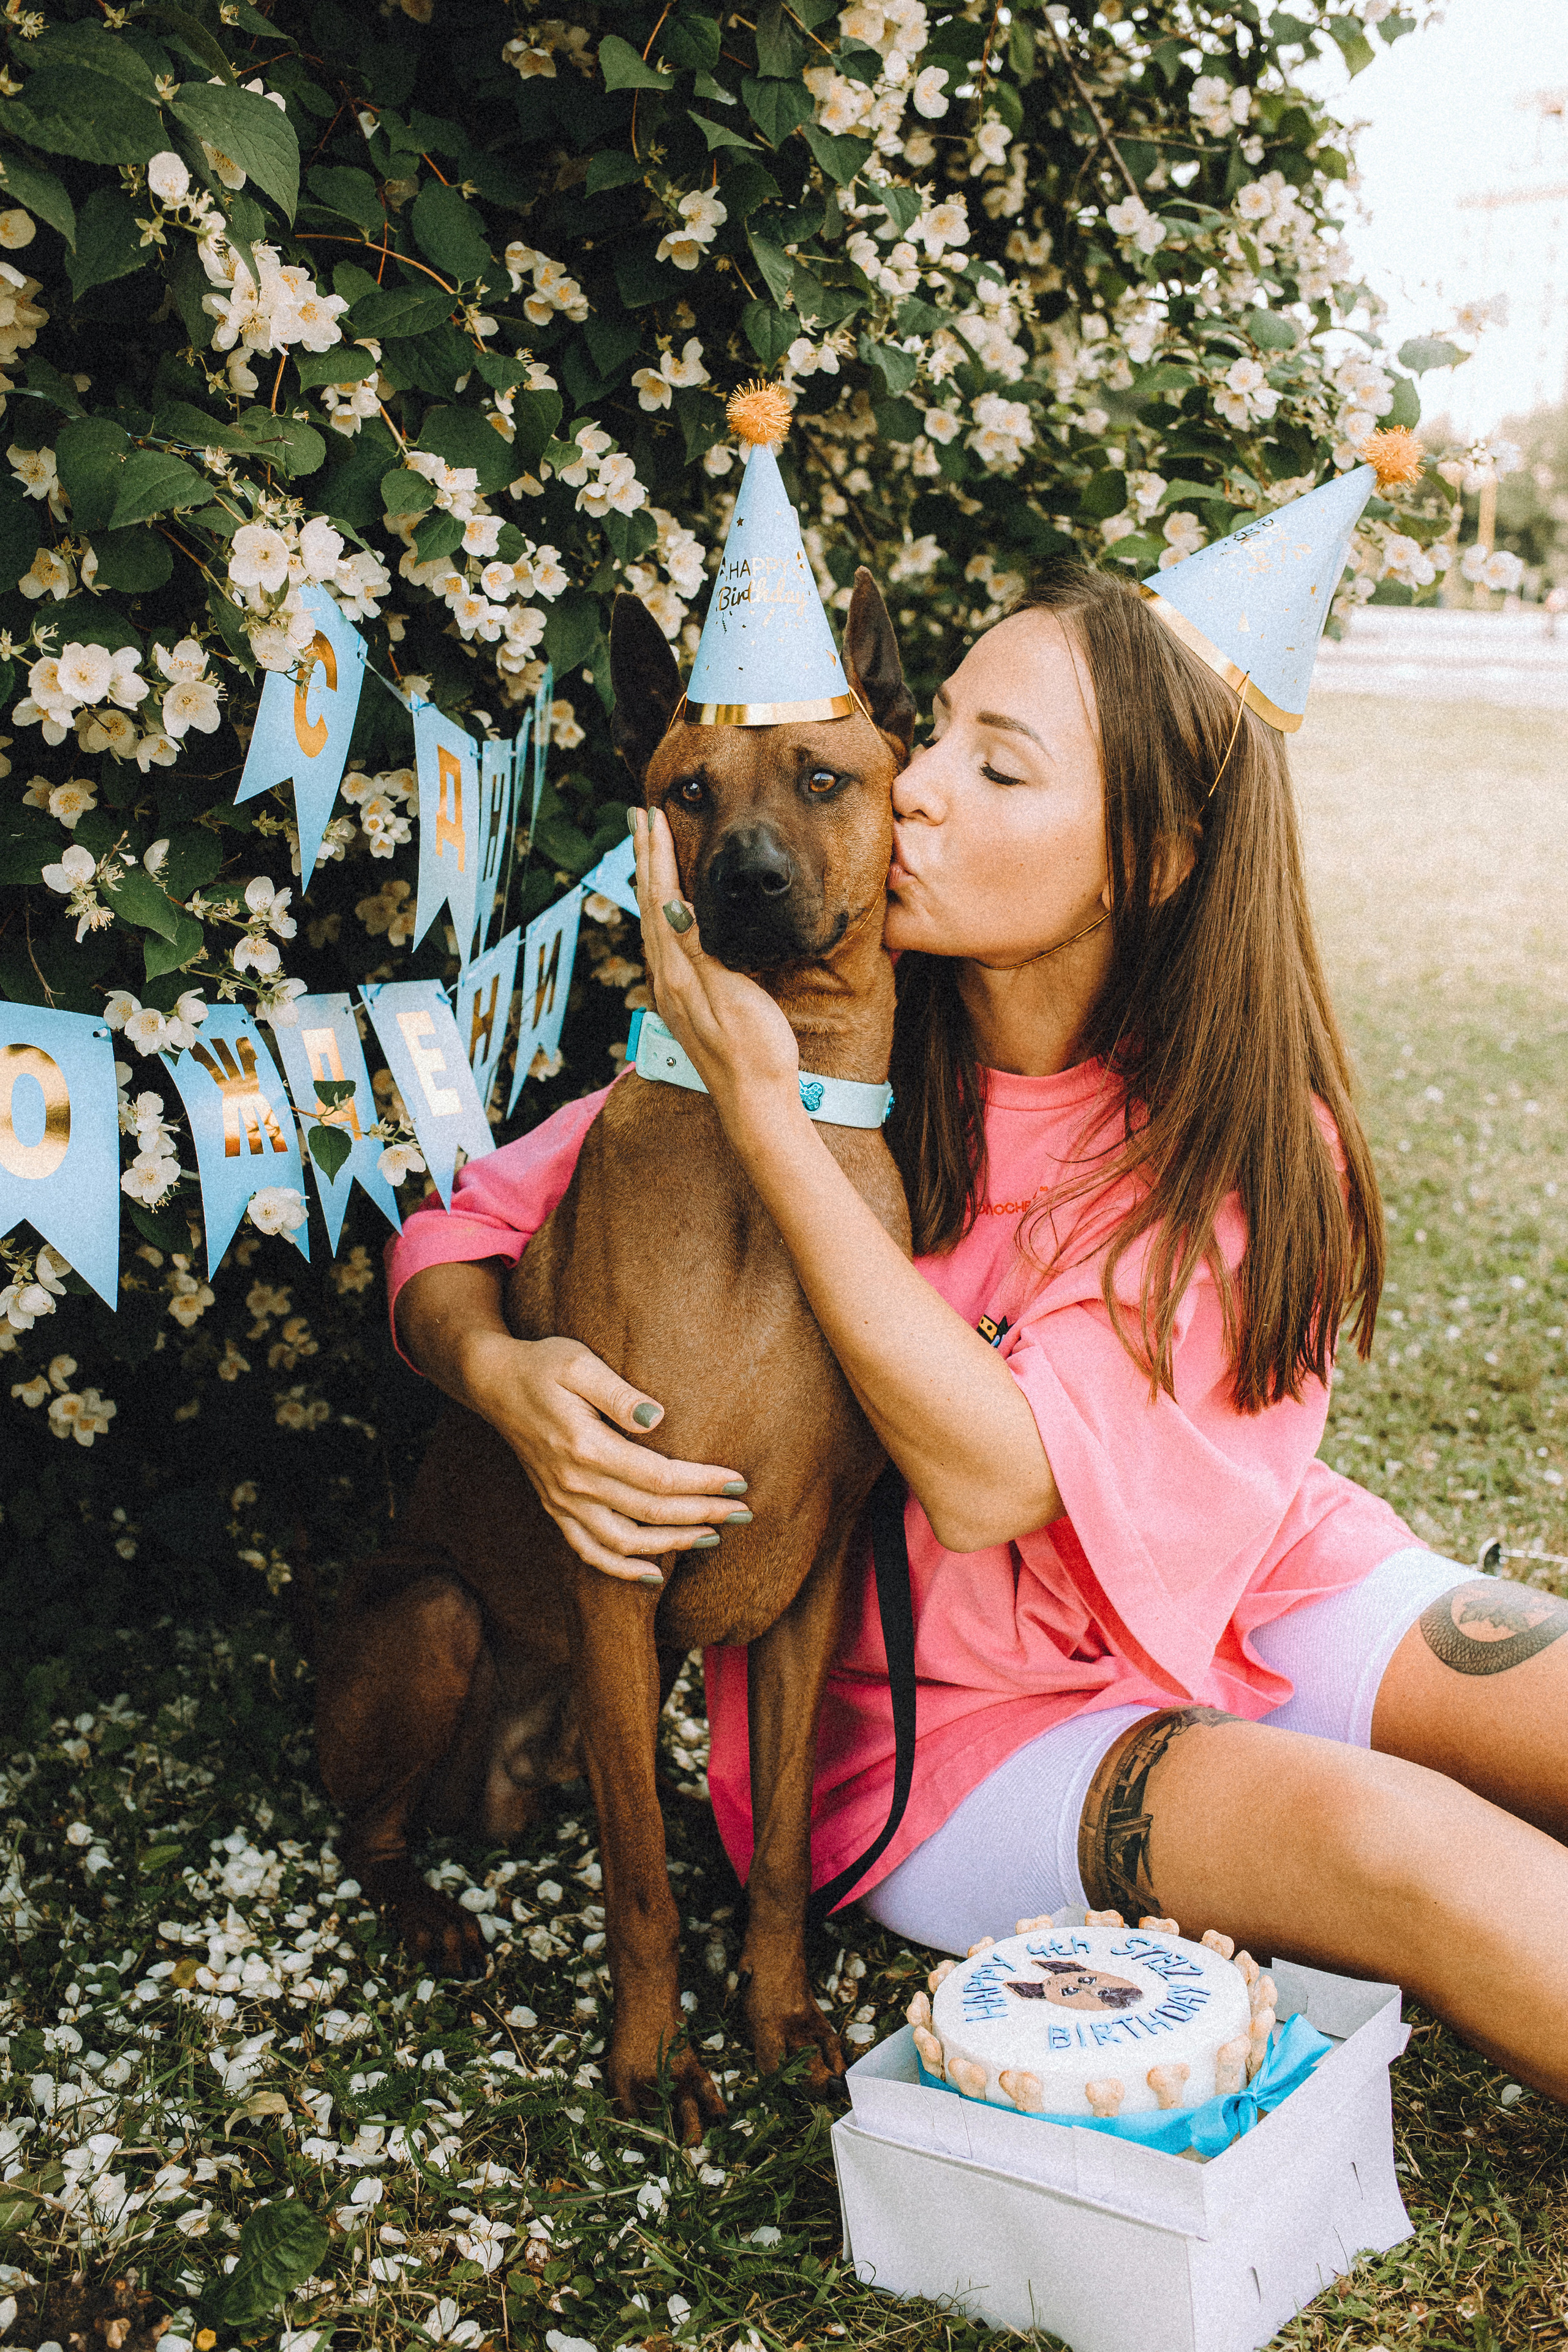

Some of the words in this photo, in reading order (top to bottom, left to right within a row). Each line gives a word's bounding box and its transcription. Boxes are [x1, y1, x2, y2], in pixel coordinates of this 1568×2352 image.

[729, 557, 791, 581] HAPPY
[718, 576, 807, 617] Birthday
[963, 1953, 1016, 2021] HAPPY
[1049, 1983, 1211, 2050] BIRTHDAY
